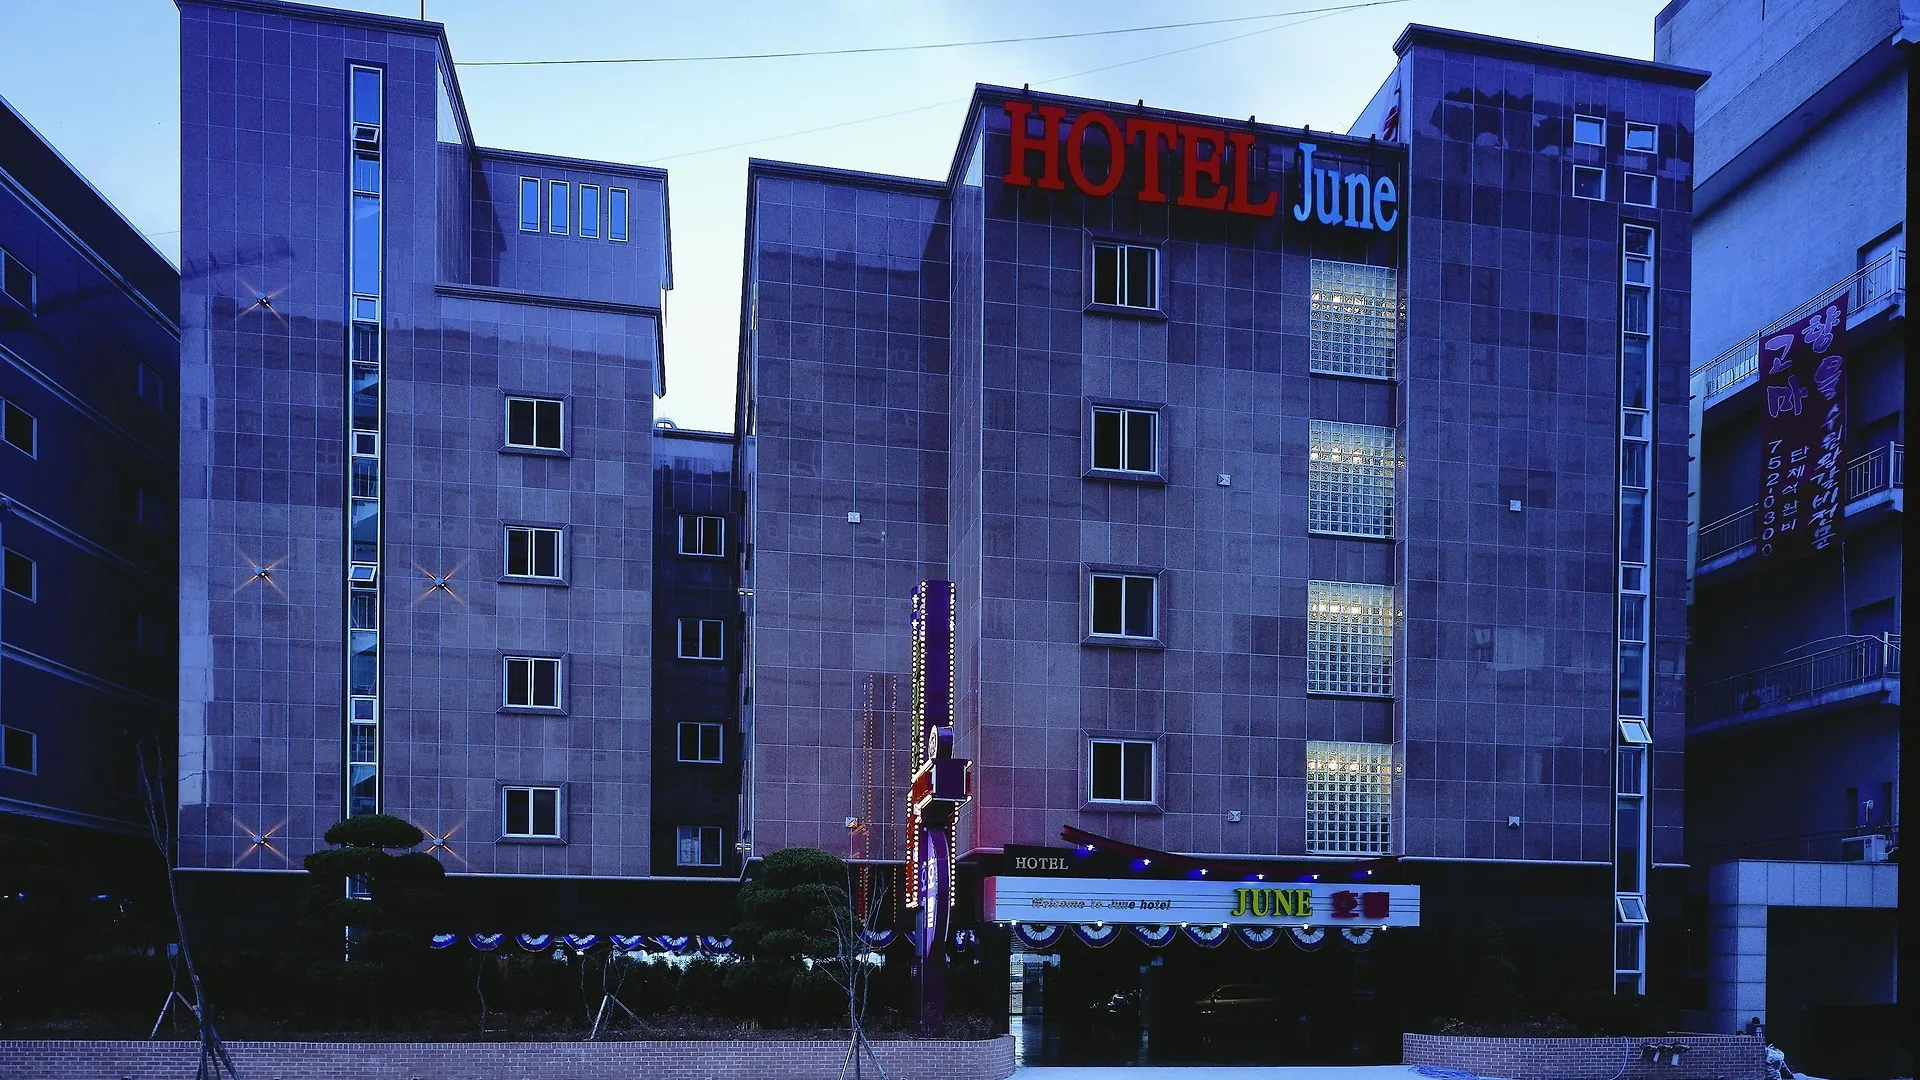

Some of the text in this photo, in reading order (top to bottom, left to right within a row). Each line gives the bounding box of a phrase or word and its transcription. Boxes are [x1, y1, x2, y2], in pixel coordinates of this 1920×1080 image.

[1004, 101, 1398, 232] HOTEL June
[1015, 857, 1069, 870] HOTEL
[1032, 897, 1171, 911] Welcome to June hotel
[1232, 888, 1313, 917] JUNE
